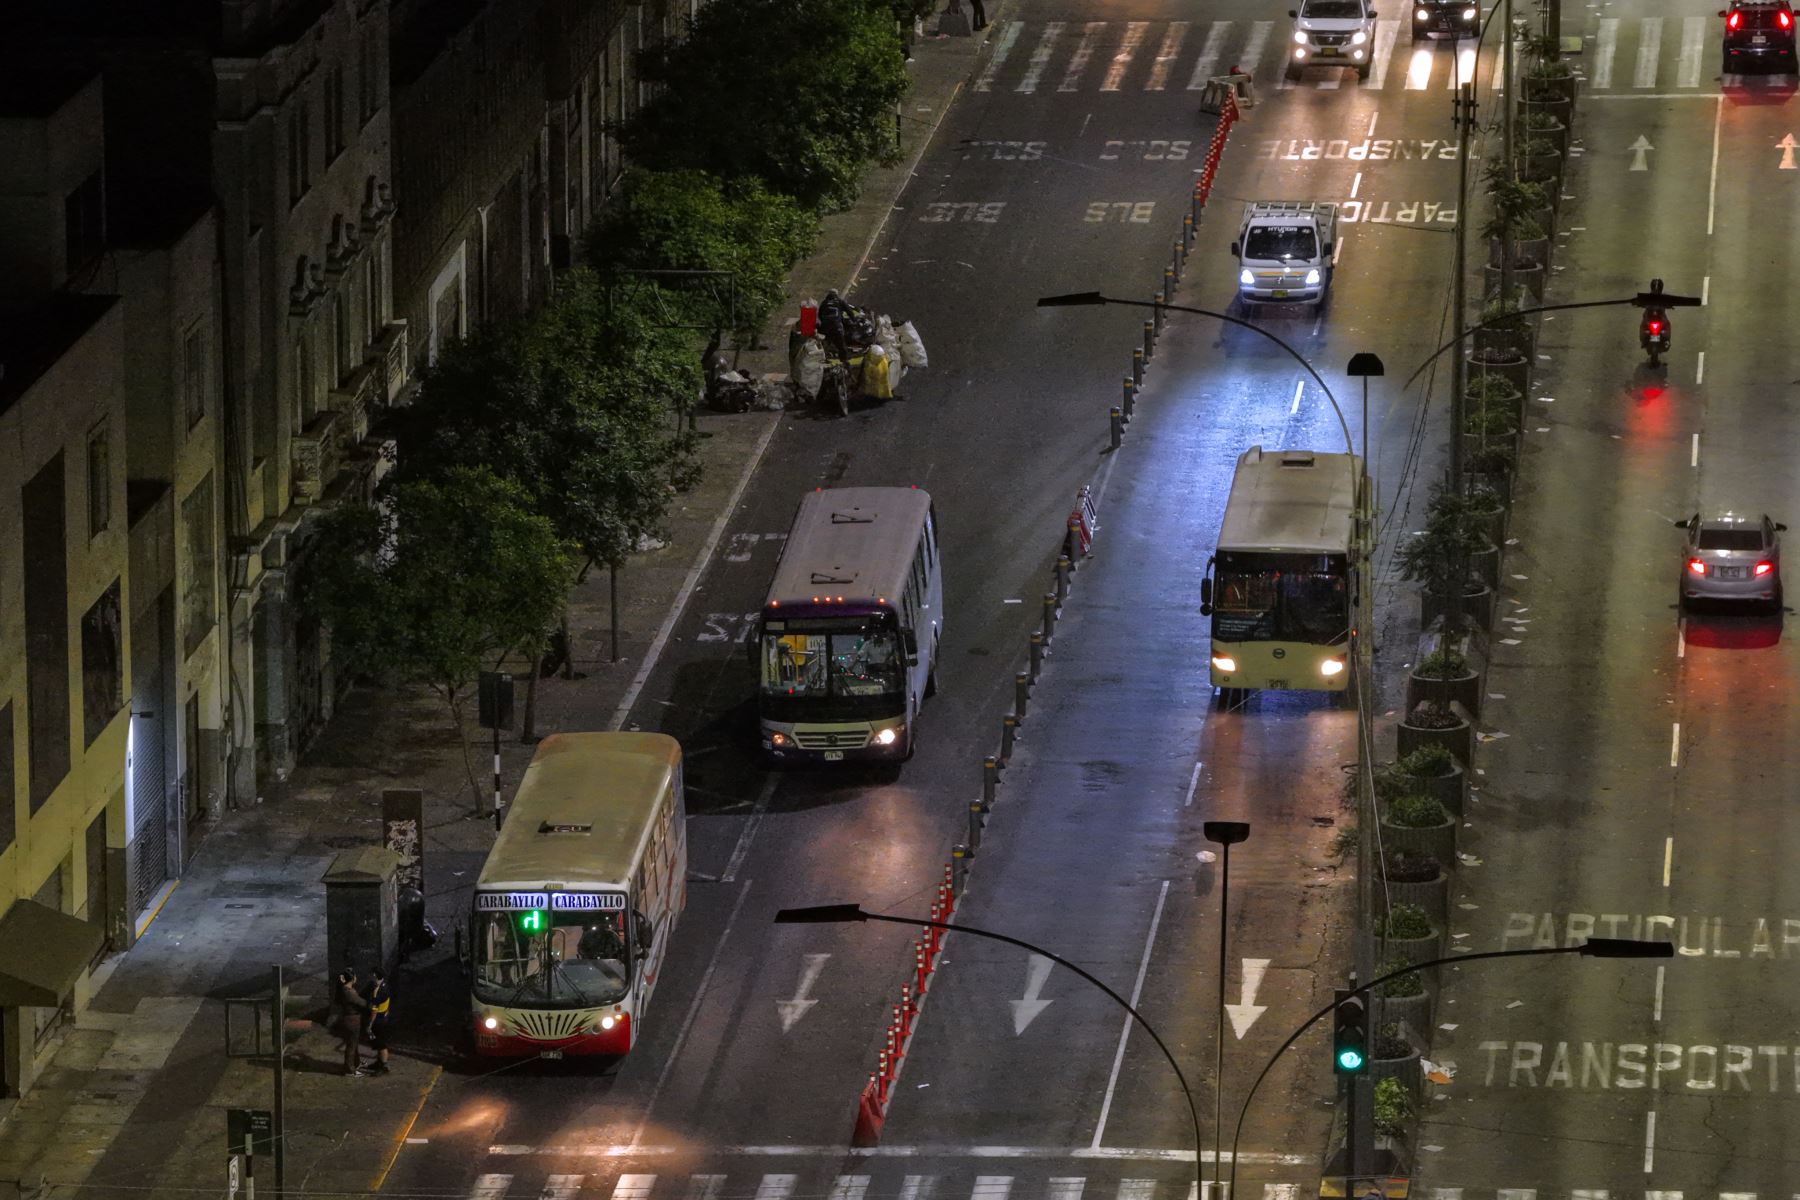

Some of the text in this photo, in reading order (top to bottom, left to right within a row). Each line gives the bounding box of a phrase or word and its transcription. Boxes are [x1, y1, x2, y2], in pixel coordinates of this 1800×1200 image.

[1256, 139, 1480, 160] TRANSPORTE
[1333, 201, 1458, 223] PARTIC
[478, 895, 623, 908] CARABAYLLO CARABAYLLO
[1476, 1040, 1800, 1092] TRANSPORT
